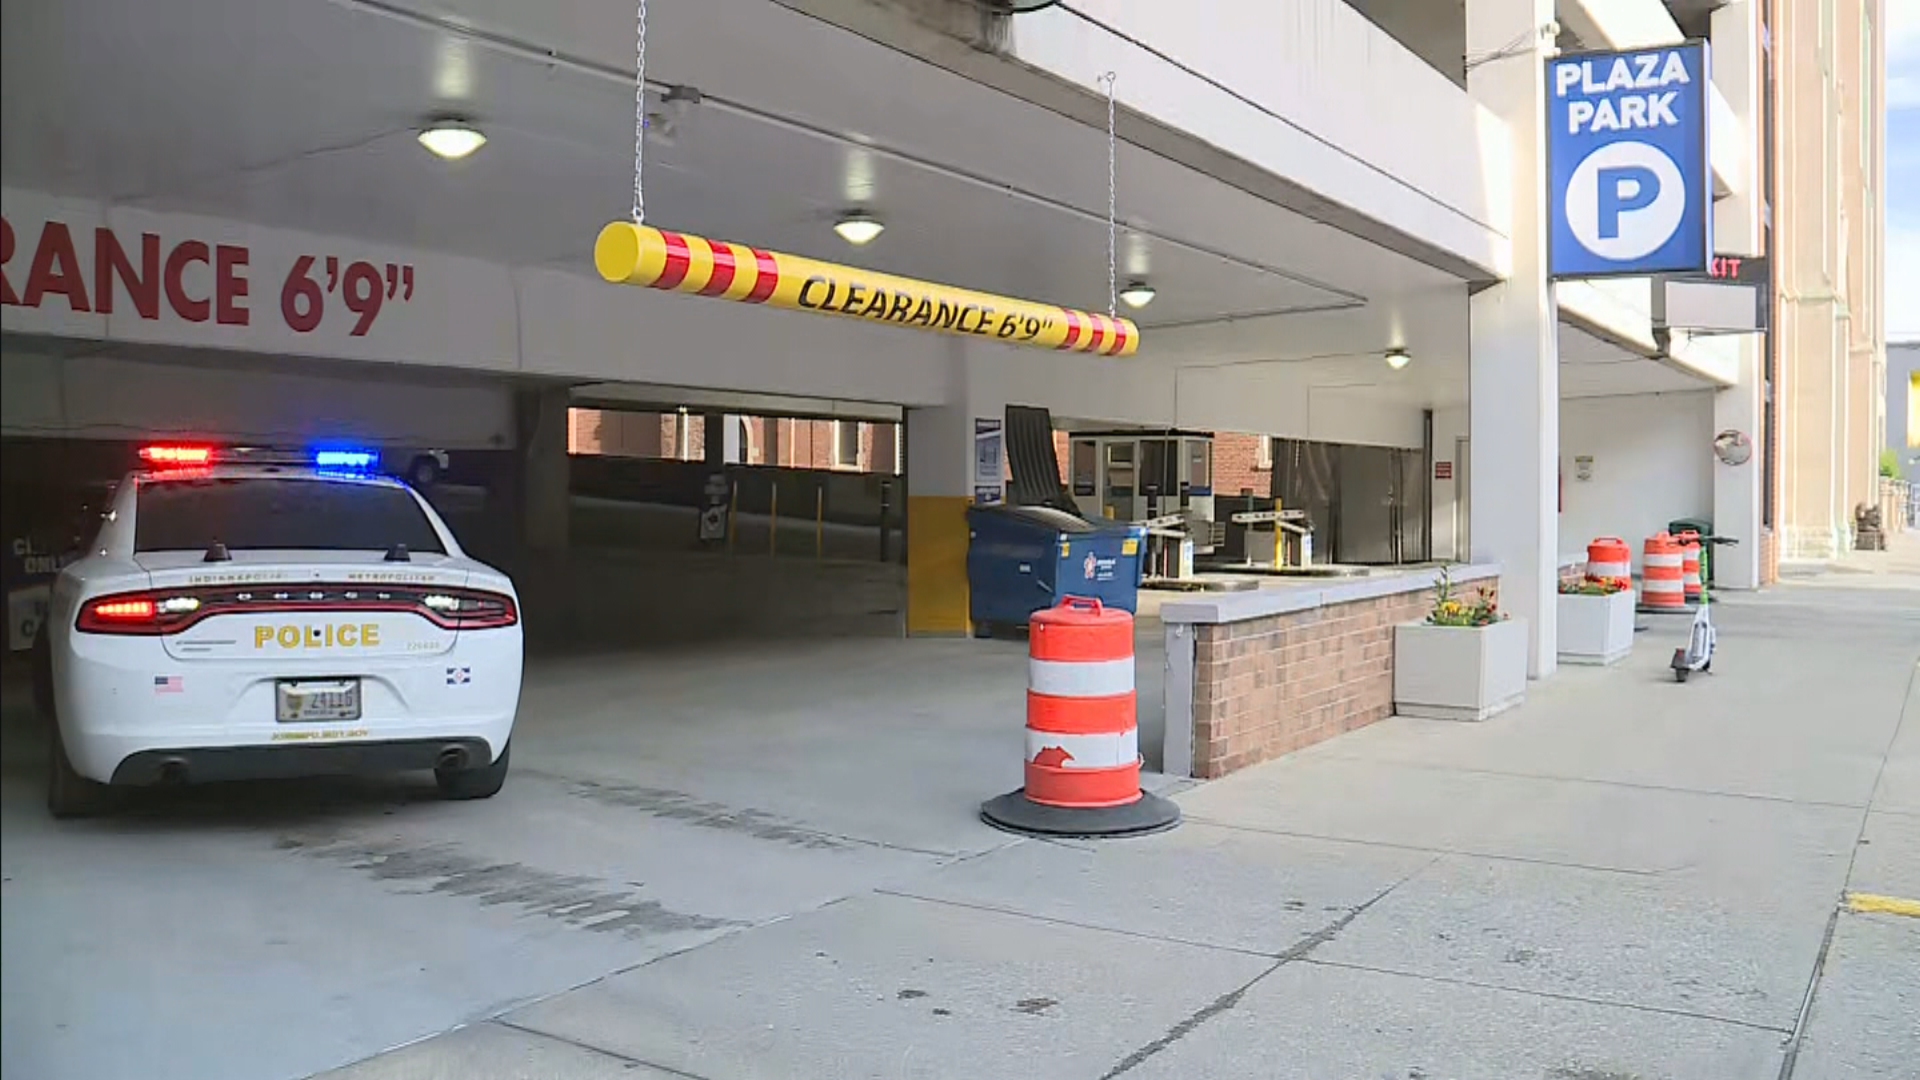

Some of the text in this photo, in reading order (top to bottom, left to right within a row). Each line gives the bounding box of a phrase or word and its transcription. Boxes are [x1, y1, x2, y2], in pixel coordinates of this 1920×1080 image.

[1556, 51, 1690, 96] PLAZA
[1568, 91, 1680, 134] PARK
[1597, 165, 1661, 240] P
[797, 274, 995, 335] CLEARANCE
[254, 623, 381, 650] POLICE
